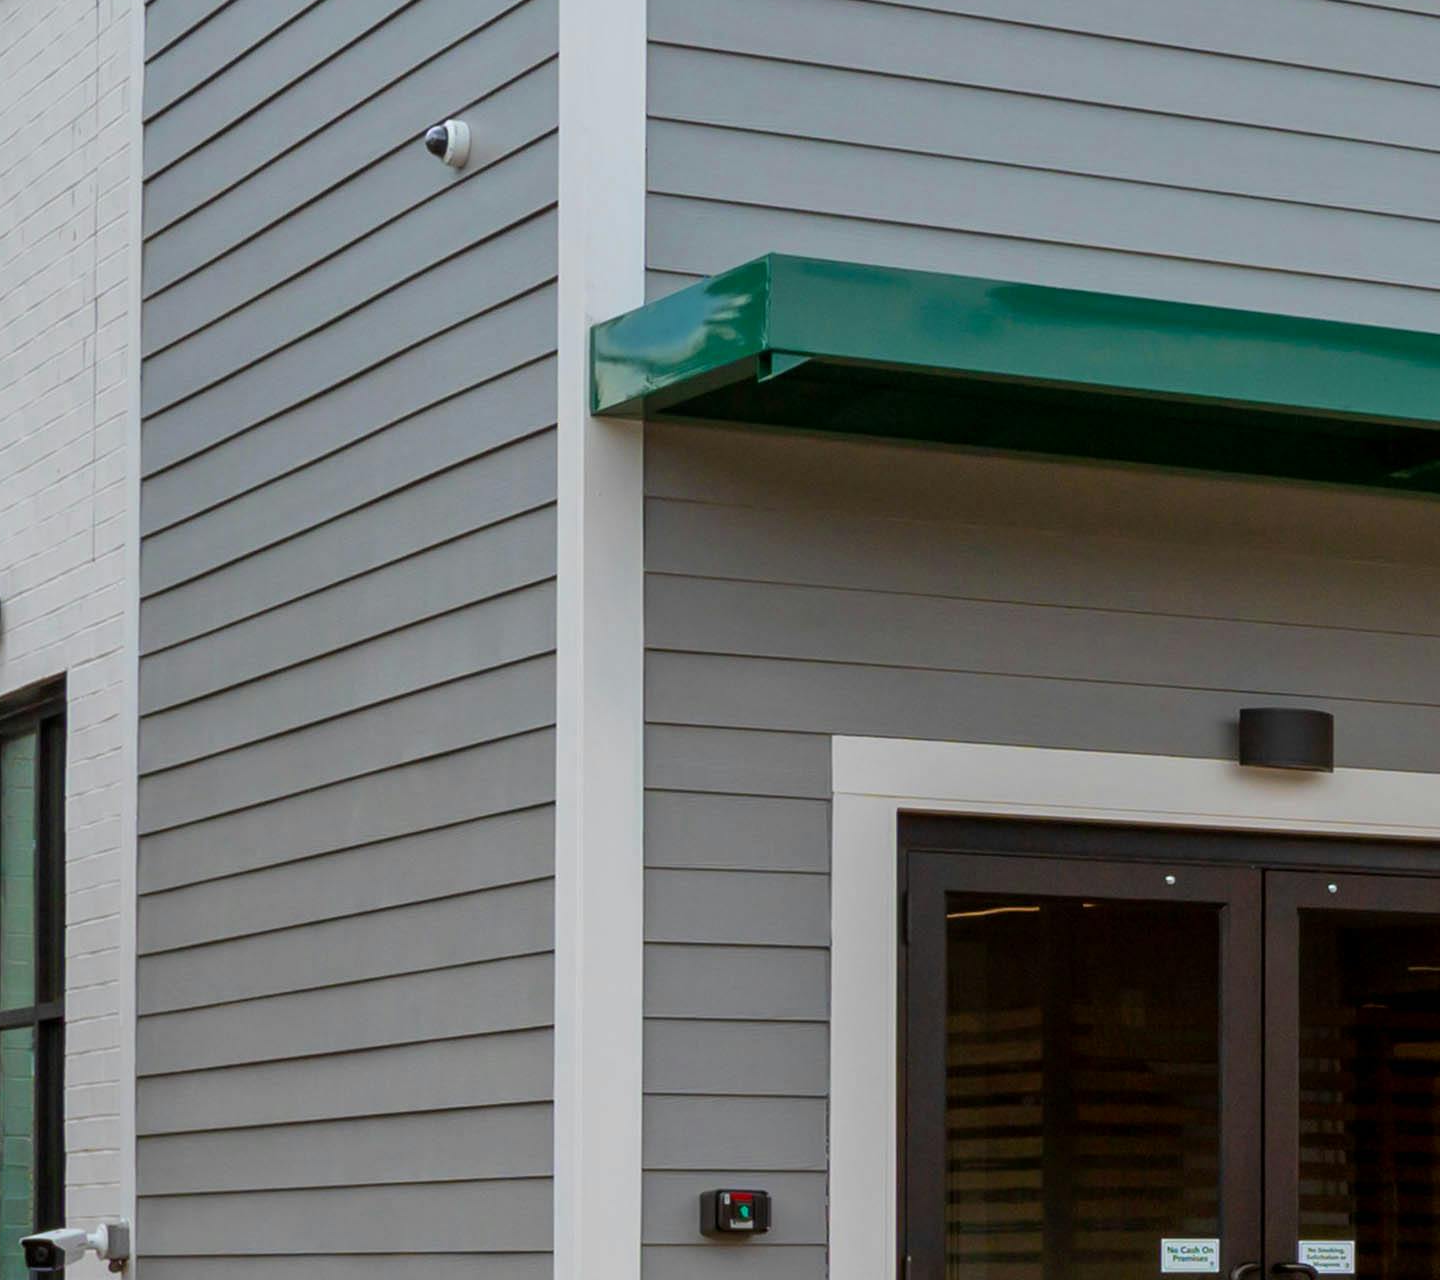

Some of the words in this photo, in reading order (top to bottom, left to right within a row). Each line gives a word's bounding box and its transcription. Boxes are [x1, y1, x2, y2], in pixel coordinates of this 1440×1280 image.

[1167, 1246, 1178, 1254] No
[1180, 1246, 1200, 1254] Cash
[1202, 1246, 1214, 1254] On
